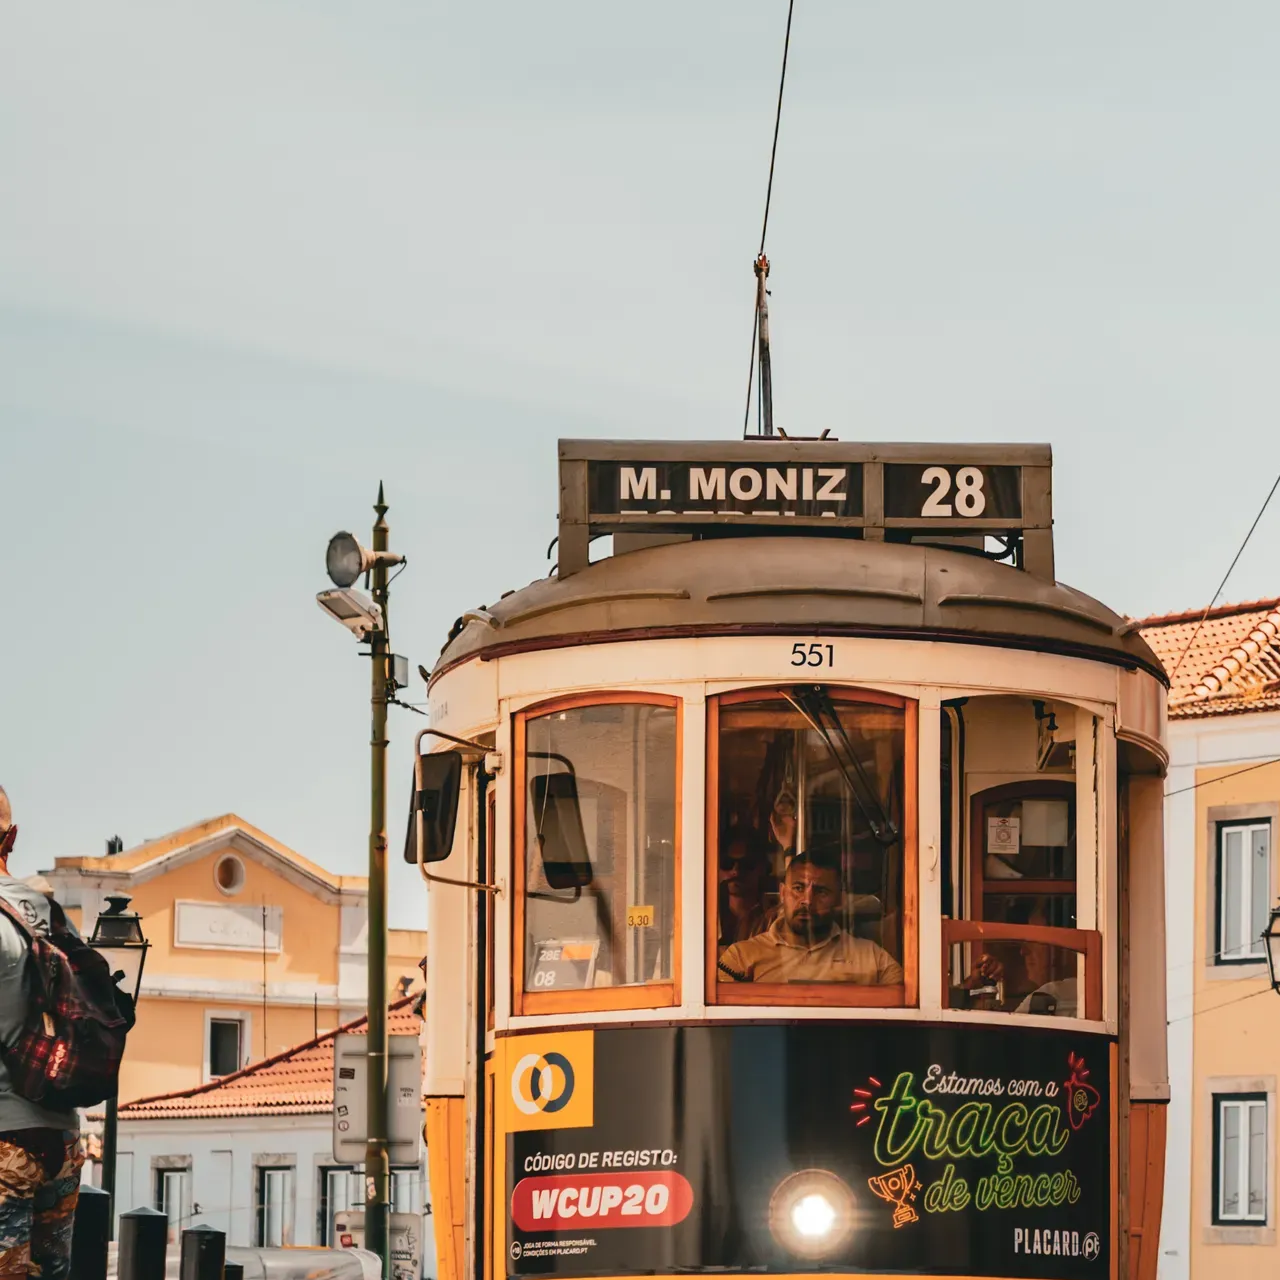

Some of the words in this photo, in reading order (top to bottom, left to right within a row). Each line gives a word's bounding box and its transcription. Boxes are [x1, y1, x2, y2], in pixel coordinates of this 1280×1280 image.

[620, 467, 671, 500] M.
[689, 467, 847, 501] MONIZ
[920, 466, 986, 518] 28
[790, 643, 835, 667] 551
[539, 949, 562, 962] 28E
[534, 971, 556, 987] 08
[922, 1064, 1005, 1097] Estamos
[1007, 1077, 1041, 1097] com
[1044, 1078, 1059, 1097] a
[874, 1072, 1070, 1173] traça
[524, 1152, 575, 1172] CÓDIGO
[578, 1151, 599, 1169] DE
[601, 1149, 678, 1167] REGISTO:
[531, 1184, 670, 1220] WCUP20
[924, 1164, 970, 1213] de
[975, 1170, 1081, 1211] vencer
